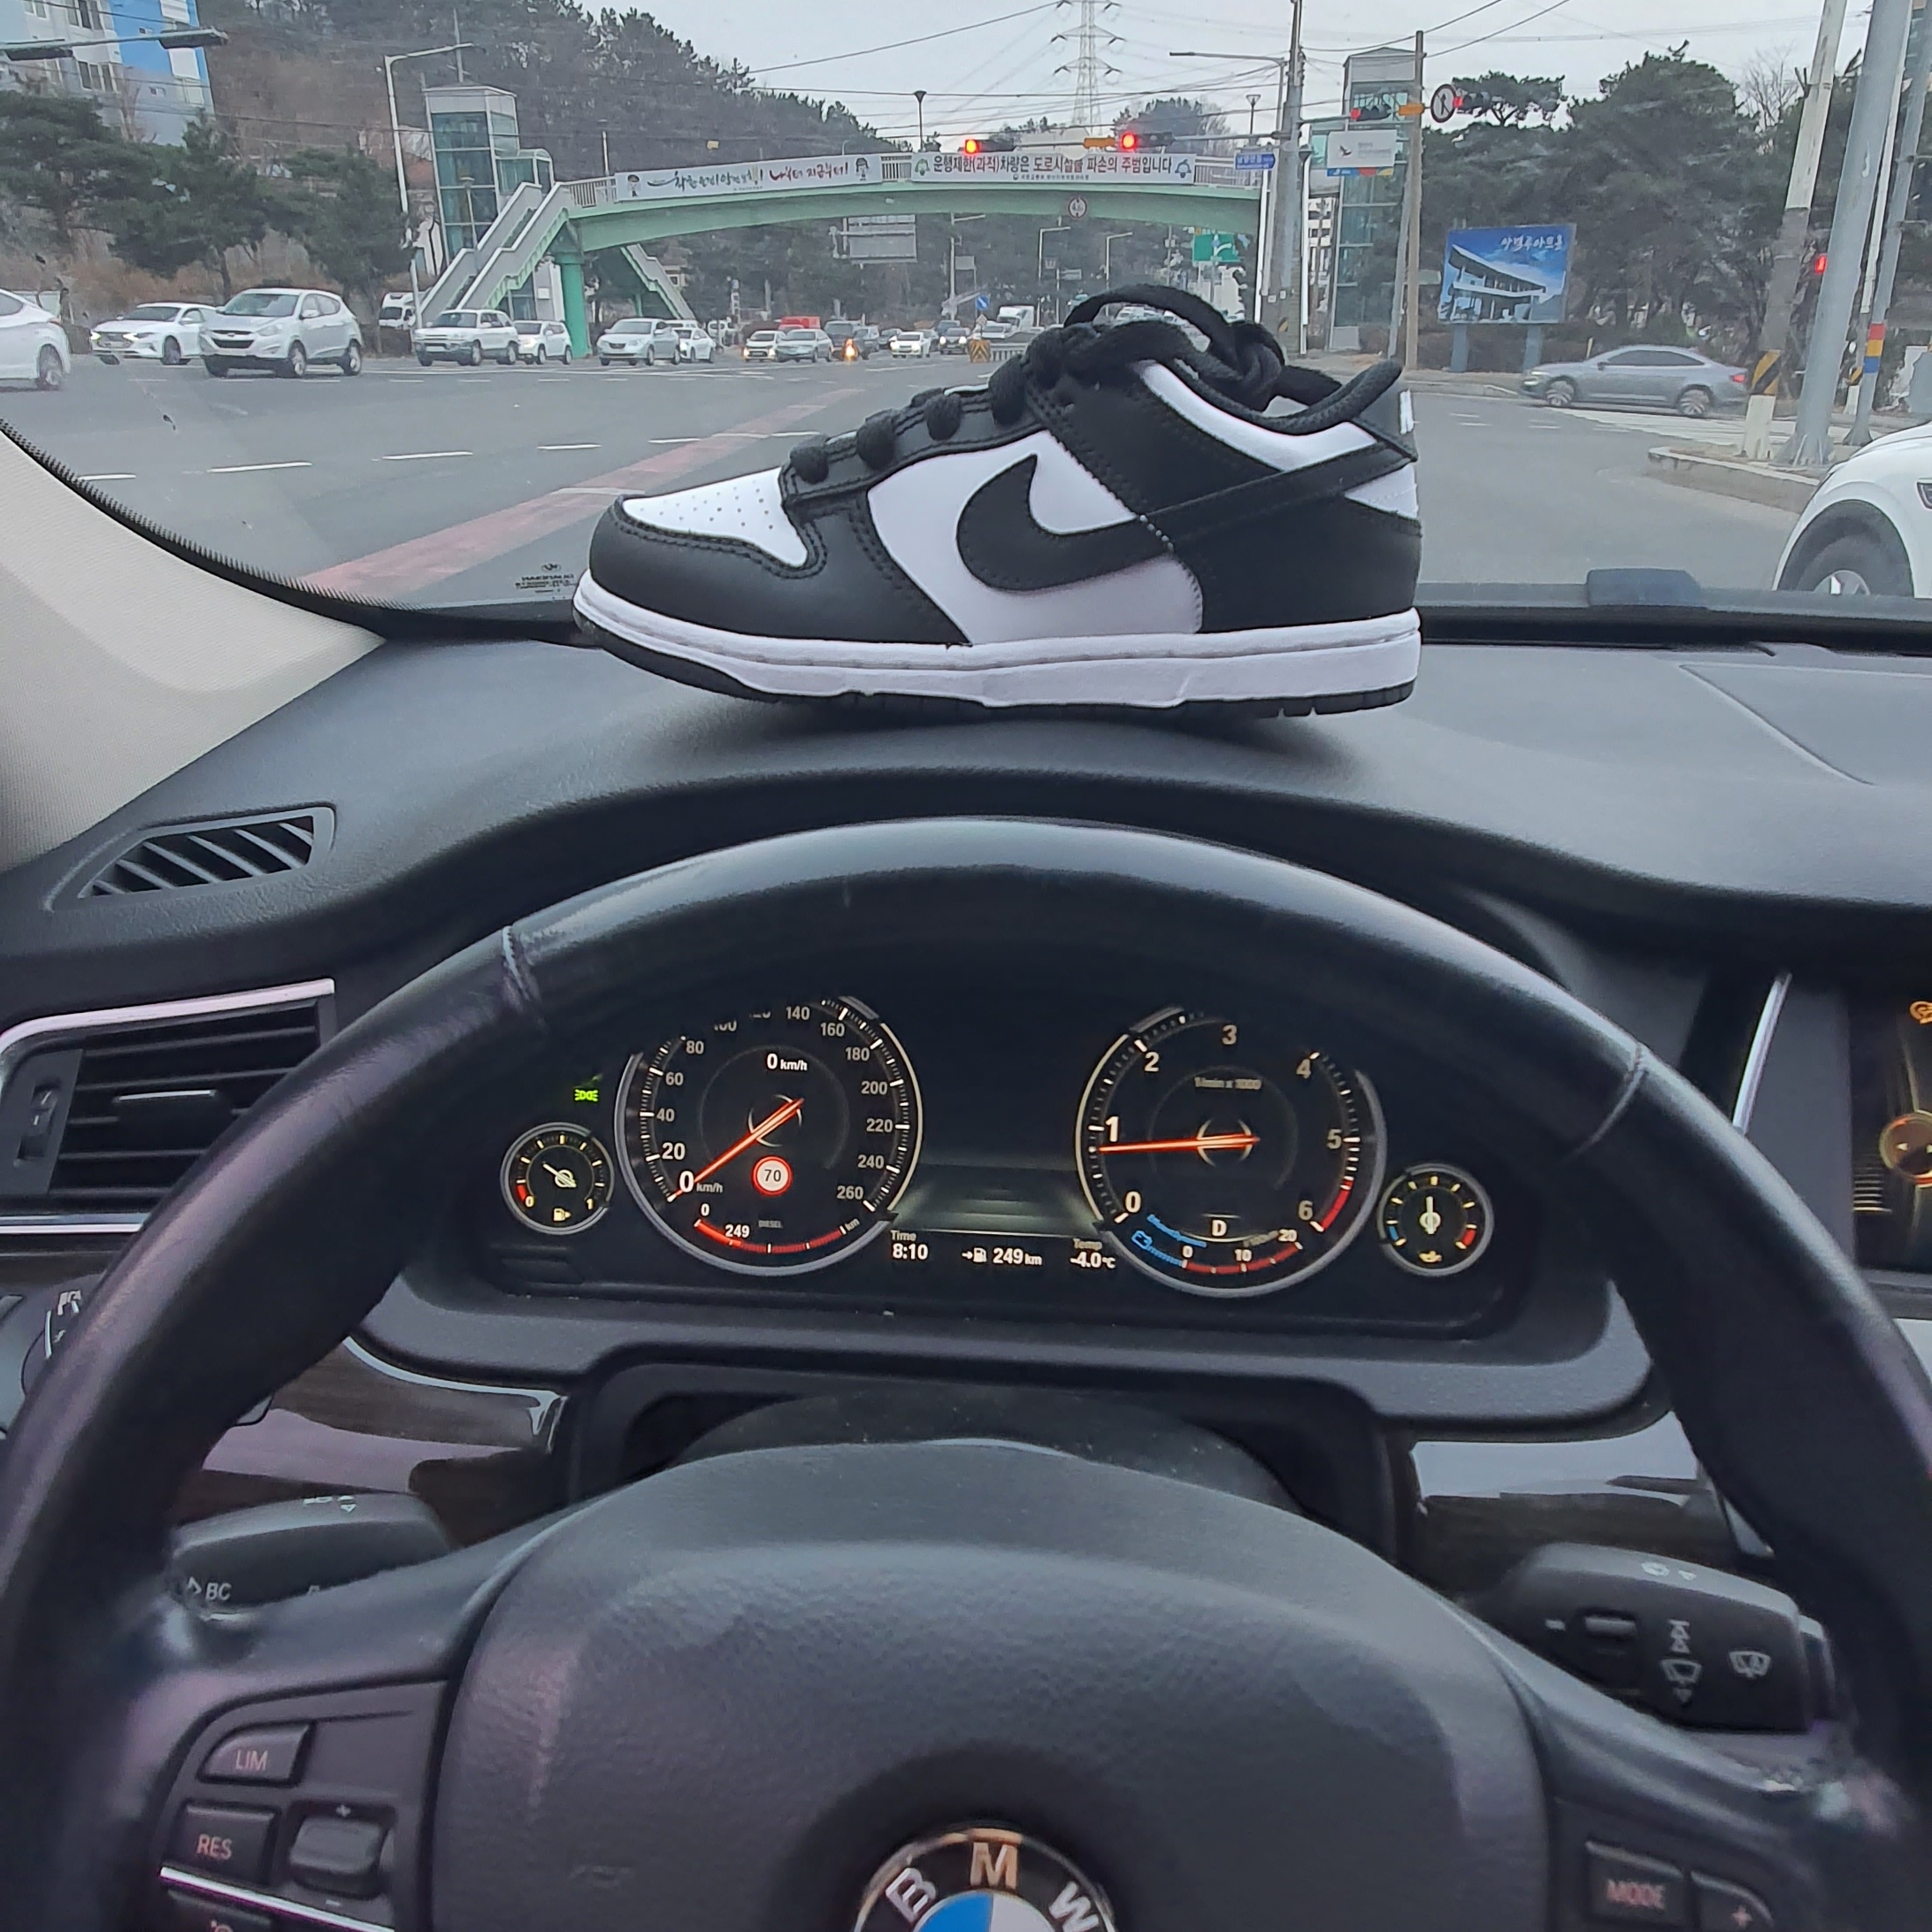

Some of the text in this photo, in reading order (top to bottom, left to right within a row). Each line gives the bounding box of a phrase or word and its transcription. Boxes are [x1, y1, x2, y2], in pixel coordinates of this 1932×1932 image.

[933, 155, 1030, 173] 운행제한(과적)차량은
[1087, 156, 1117, 173] 파손의
[1122, 156, 1172, 174] 주범입니다
[786, 1006, 810, 1021] 140
[820, 1022, 846, 1037] 160
[1222, 1024, 1238, 1045] 3
[686, 1040, 705, 1054] 80
[845, 1046, 870, 1062] 180
[766, 1053, 808, 1071] 0 km/h
[1145, 1051, 1160, 1072] 2
[1296, 1059, 1312, 1078] 4
[665, 1072, 684, 1086] 60
[861, 1081, 888, 1095] 200
[656, 1108, 675, 1122] 40
[866, 1119, 893, 1133] 220
[1105, 1116, 1119, 1142] 1
[1327, 1129, 1342, 1149] 5
[662, 1143, 686, 1161] 20
[857, 1155, 885, 1169] 240
[678, 1171, 724, 1194] 0 km/h
[763, 1169, 782, 1183] 70
[837, 1186, 864, 1200] 260
[525, 1195, 535, 1208] 0
[586, 1198, 594, 1210] 1
[700, 1203, 709, 1216] 0
[1125, 1192, 1142, 1213] 0
[1298, 1200, 1314, 1221] 6
[724, 1224, 750, 1238] 249
[890, 1229, 917, 1241] Time
[1211, 1219, 1228, 1237] D
[892, 1243, 929, 1260] 8:10
[1073, 1238, 1103, 1250] Temp
[1182, 1245, 1193, 1258] 0
[992, 1247, 1043, 1266] 249 km
[1234, 1248, 1253, 1262] 10
[205, 1582, 233, 1601] BC
[235, 1749, 269, 1771] LIM
[196, 1834, 233, 1860] RES
[885, 1841, 1100, 1932] BMW
[1606, 1878, 1666, 1910] MODE
